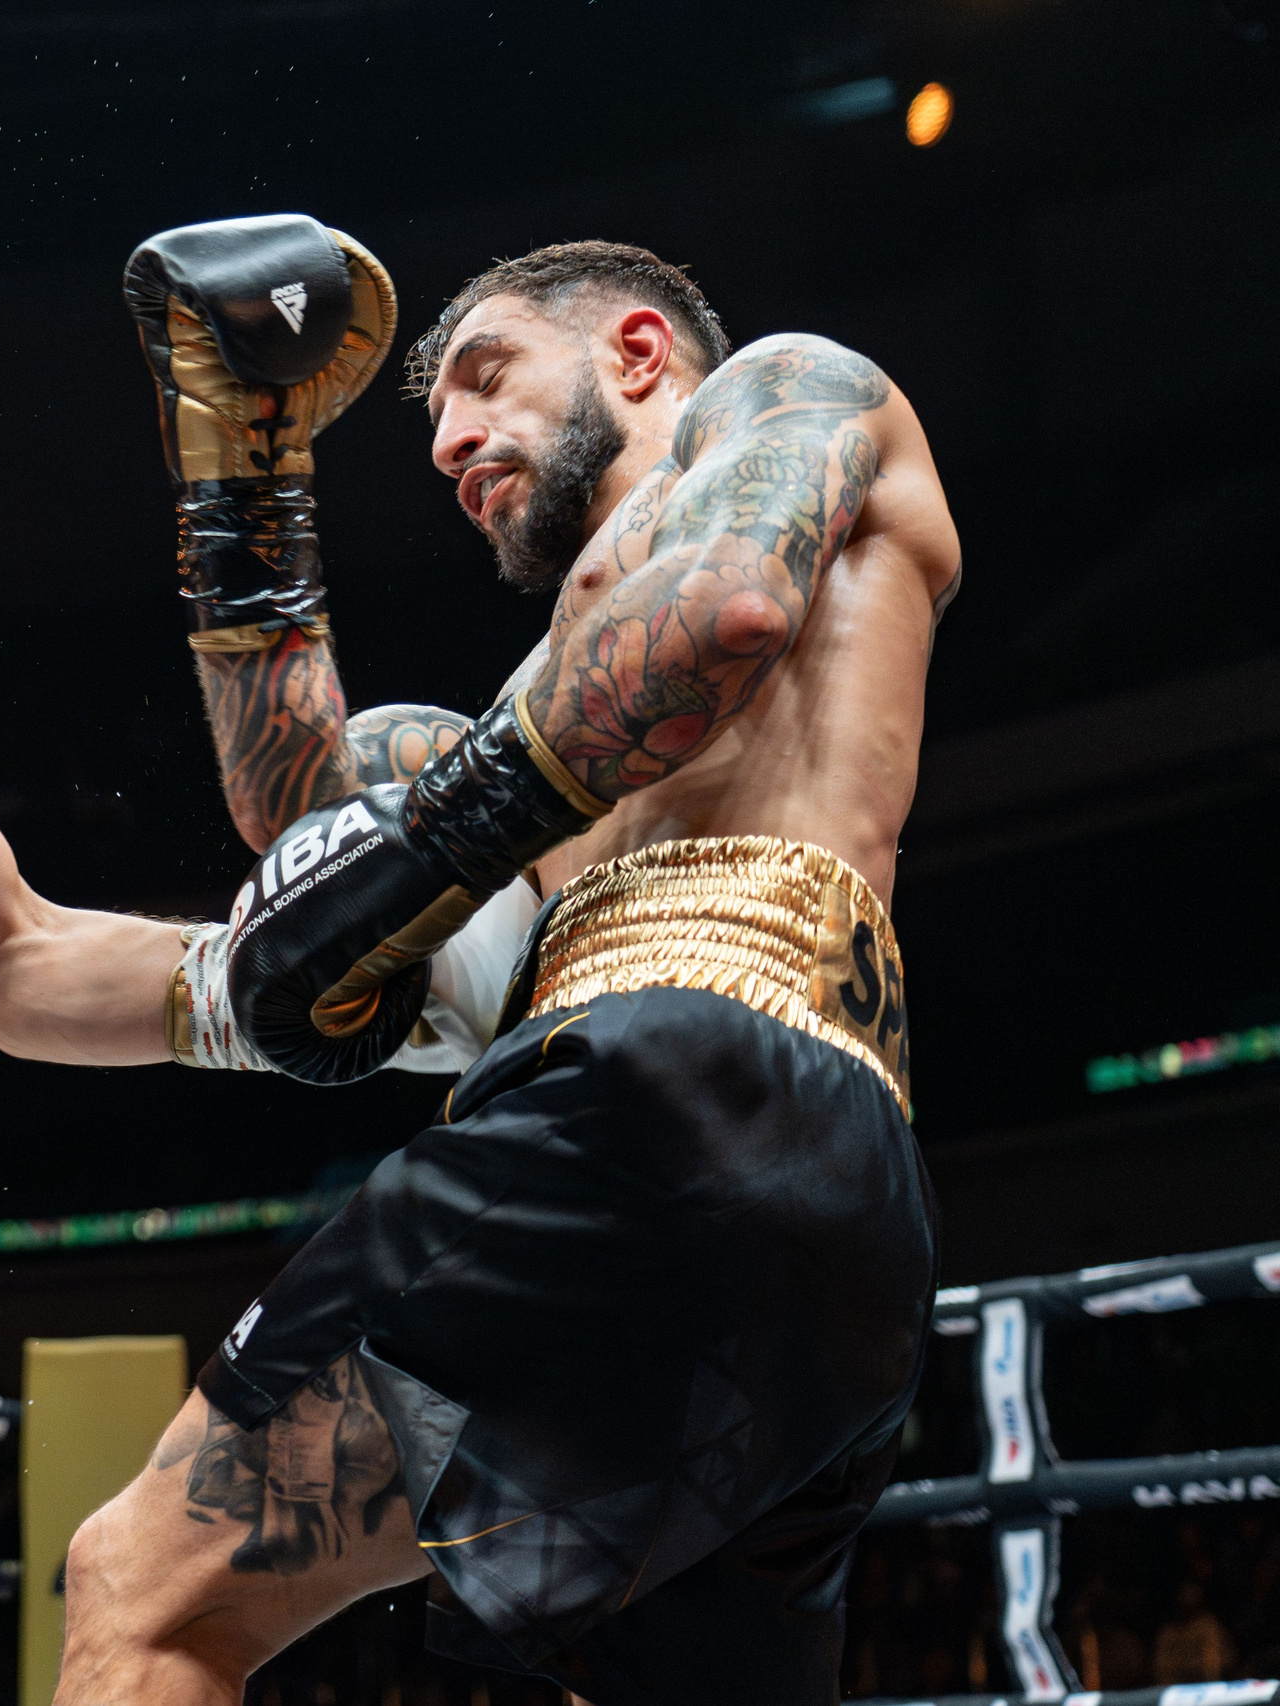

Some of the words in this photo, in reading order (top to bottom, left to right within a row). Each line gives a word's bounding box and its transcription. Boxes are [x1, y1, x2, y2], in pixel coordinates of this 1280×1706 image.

[261, 800, 379, 900] IBA
[273, 877, 315, 912] BOXING
[315, 832, 384, 885] ASSOCIATION
